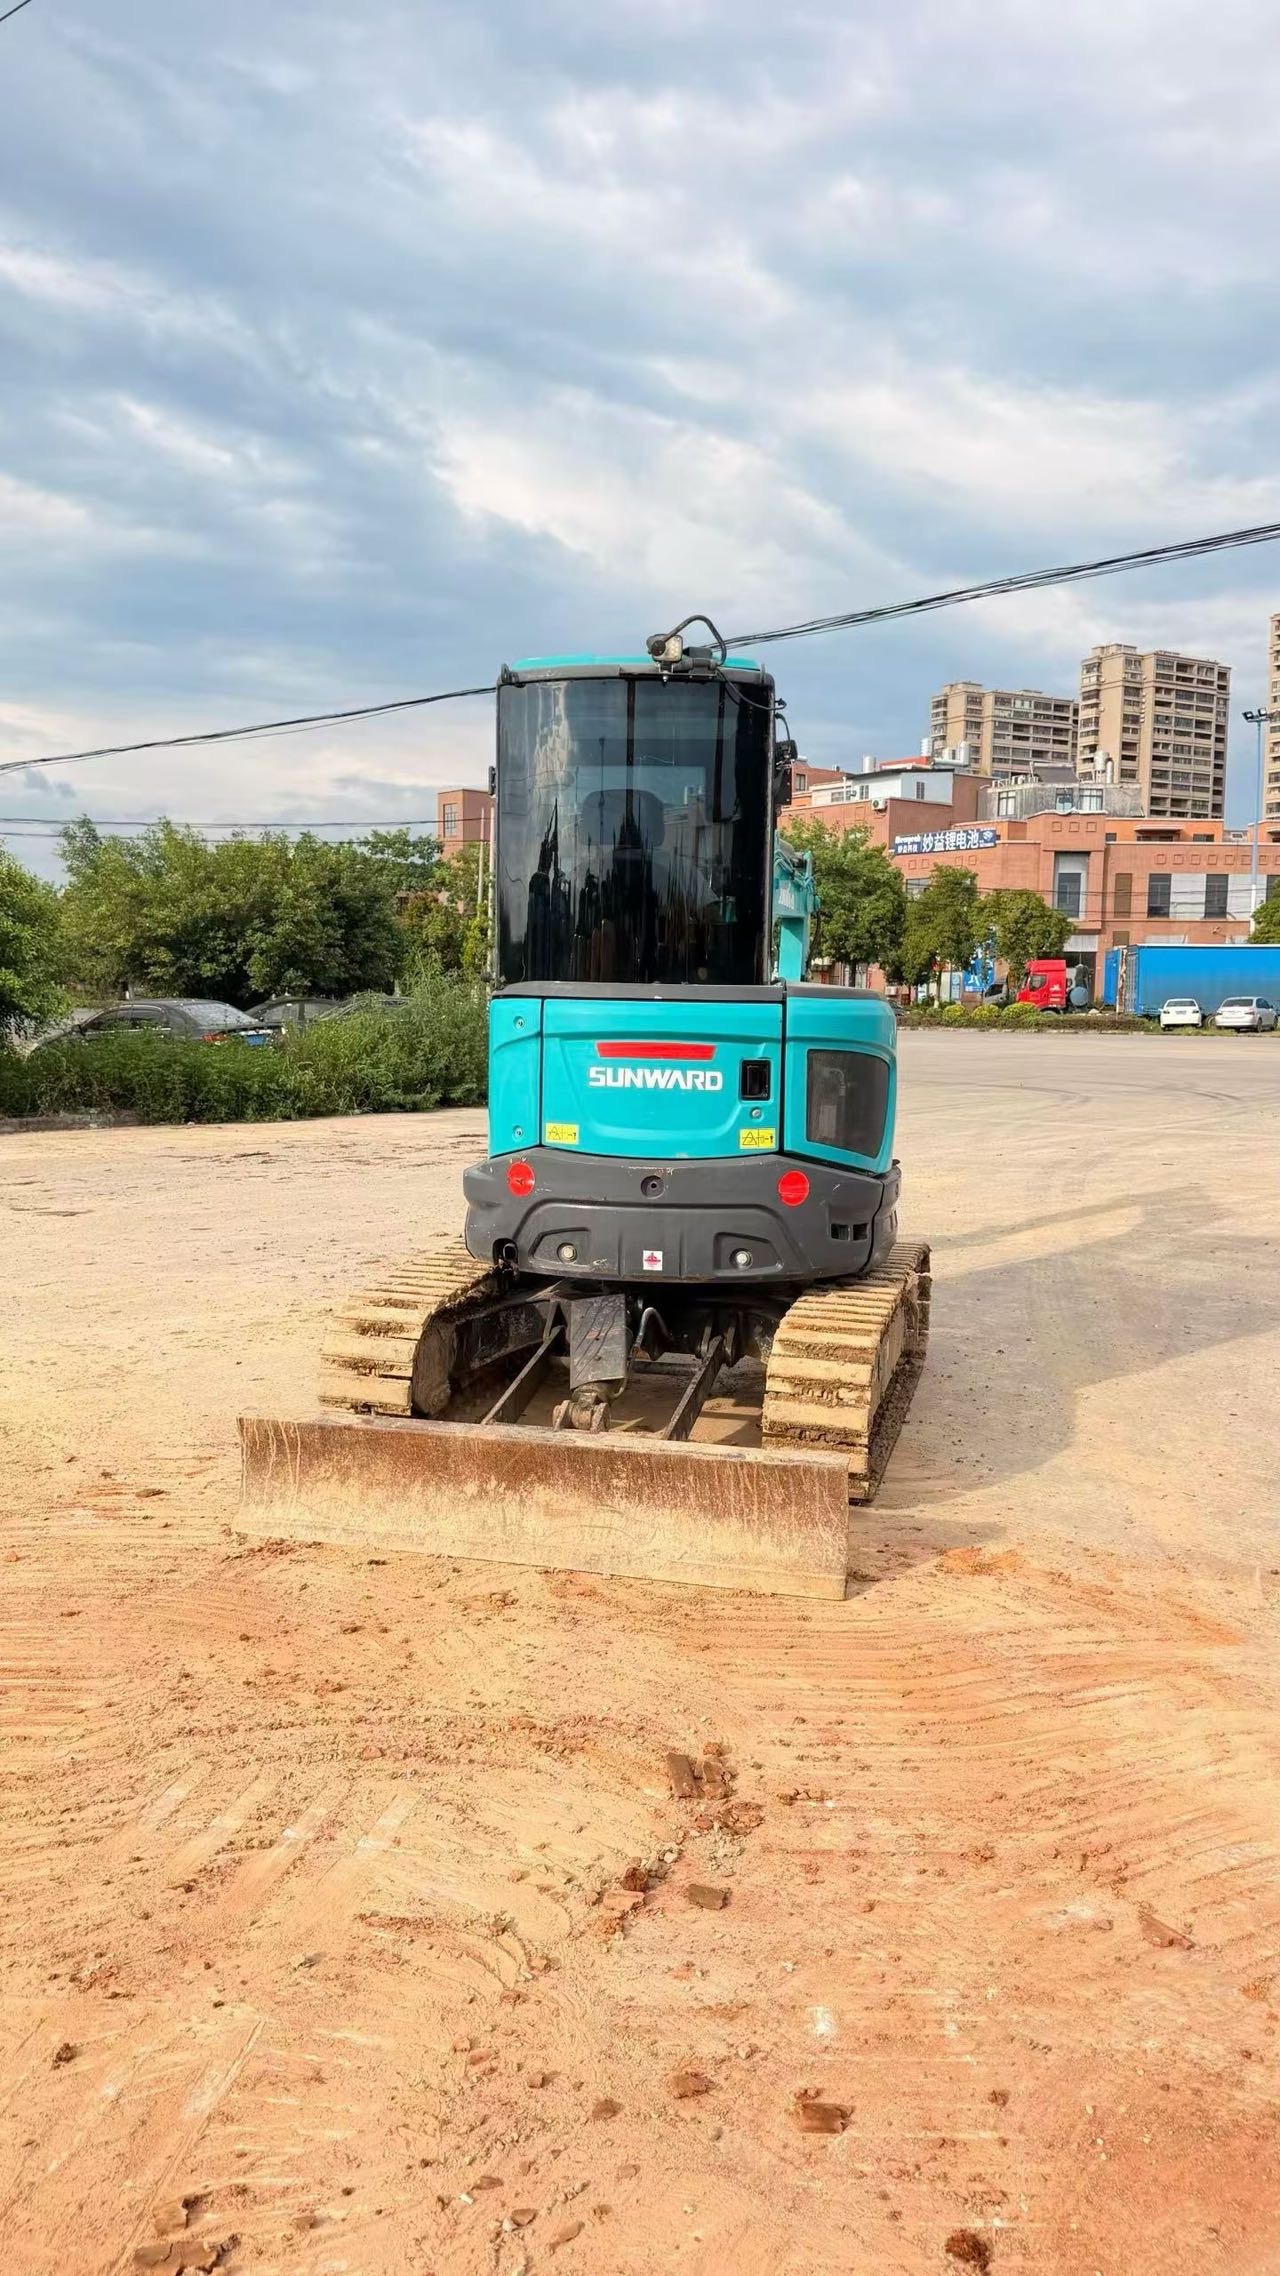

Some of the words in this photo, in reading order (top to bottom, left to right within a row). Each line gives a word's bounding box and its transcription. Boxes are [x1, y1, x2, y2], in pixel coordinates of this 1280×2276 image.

[922, 829, 979, 852] 妙益锂电池
[589, 1066, 723, 1091] SUNWARD
